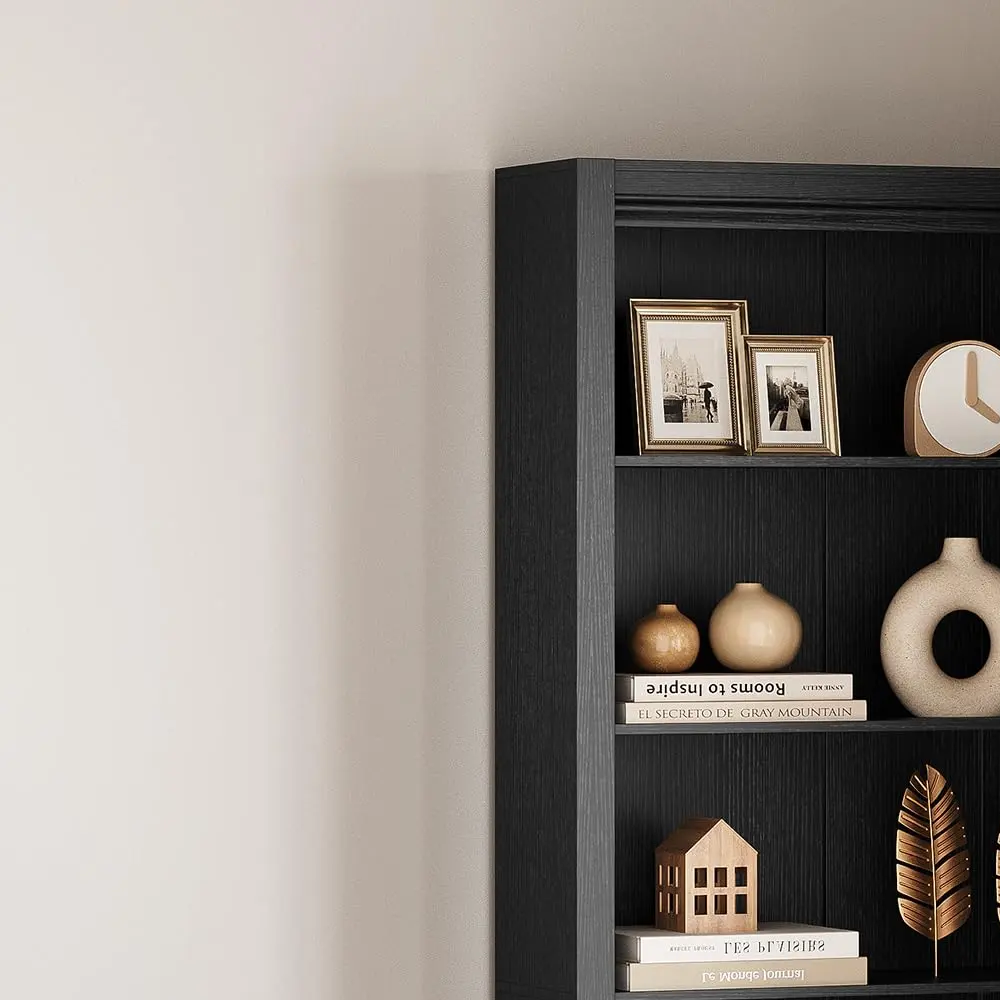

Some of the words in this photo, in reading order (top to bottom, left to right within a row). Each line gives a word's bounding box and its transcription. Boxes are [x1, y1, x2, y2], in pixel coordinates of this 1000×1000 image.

[647, 680, 702, 698] Inspire
[708, 684, 726, 695] to
[731, 683, 785, 696] Rooms
[639, 709, 652, 719] EL
[656, 709, 713, 719] SECRETO
[717, 709, 733, 718] DE
[740, 708, 775, 718] GRAY
[778, 707, 852, 718] MOUNTAIN
